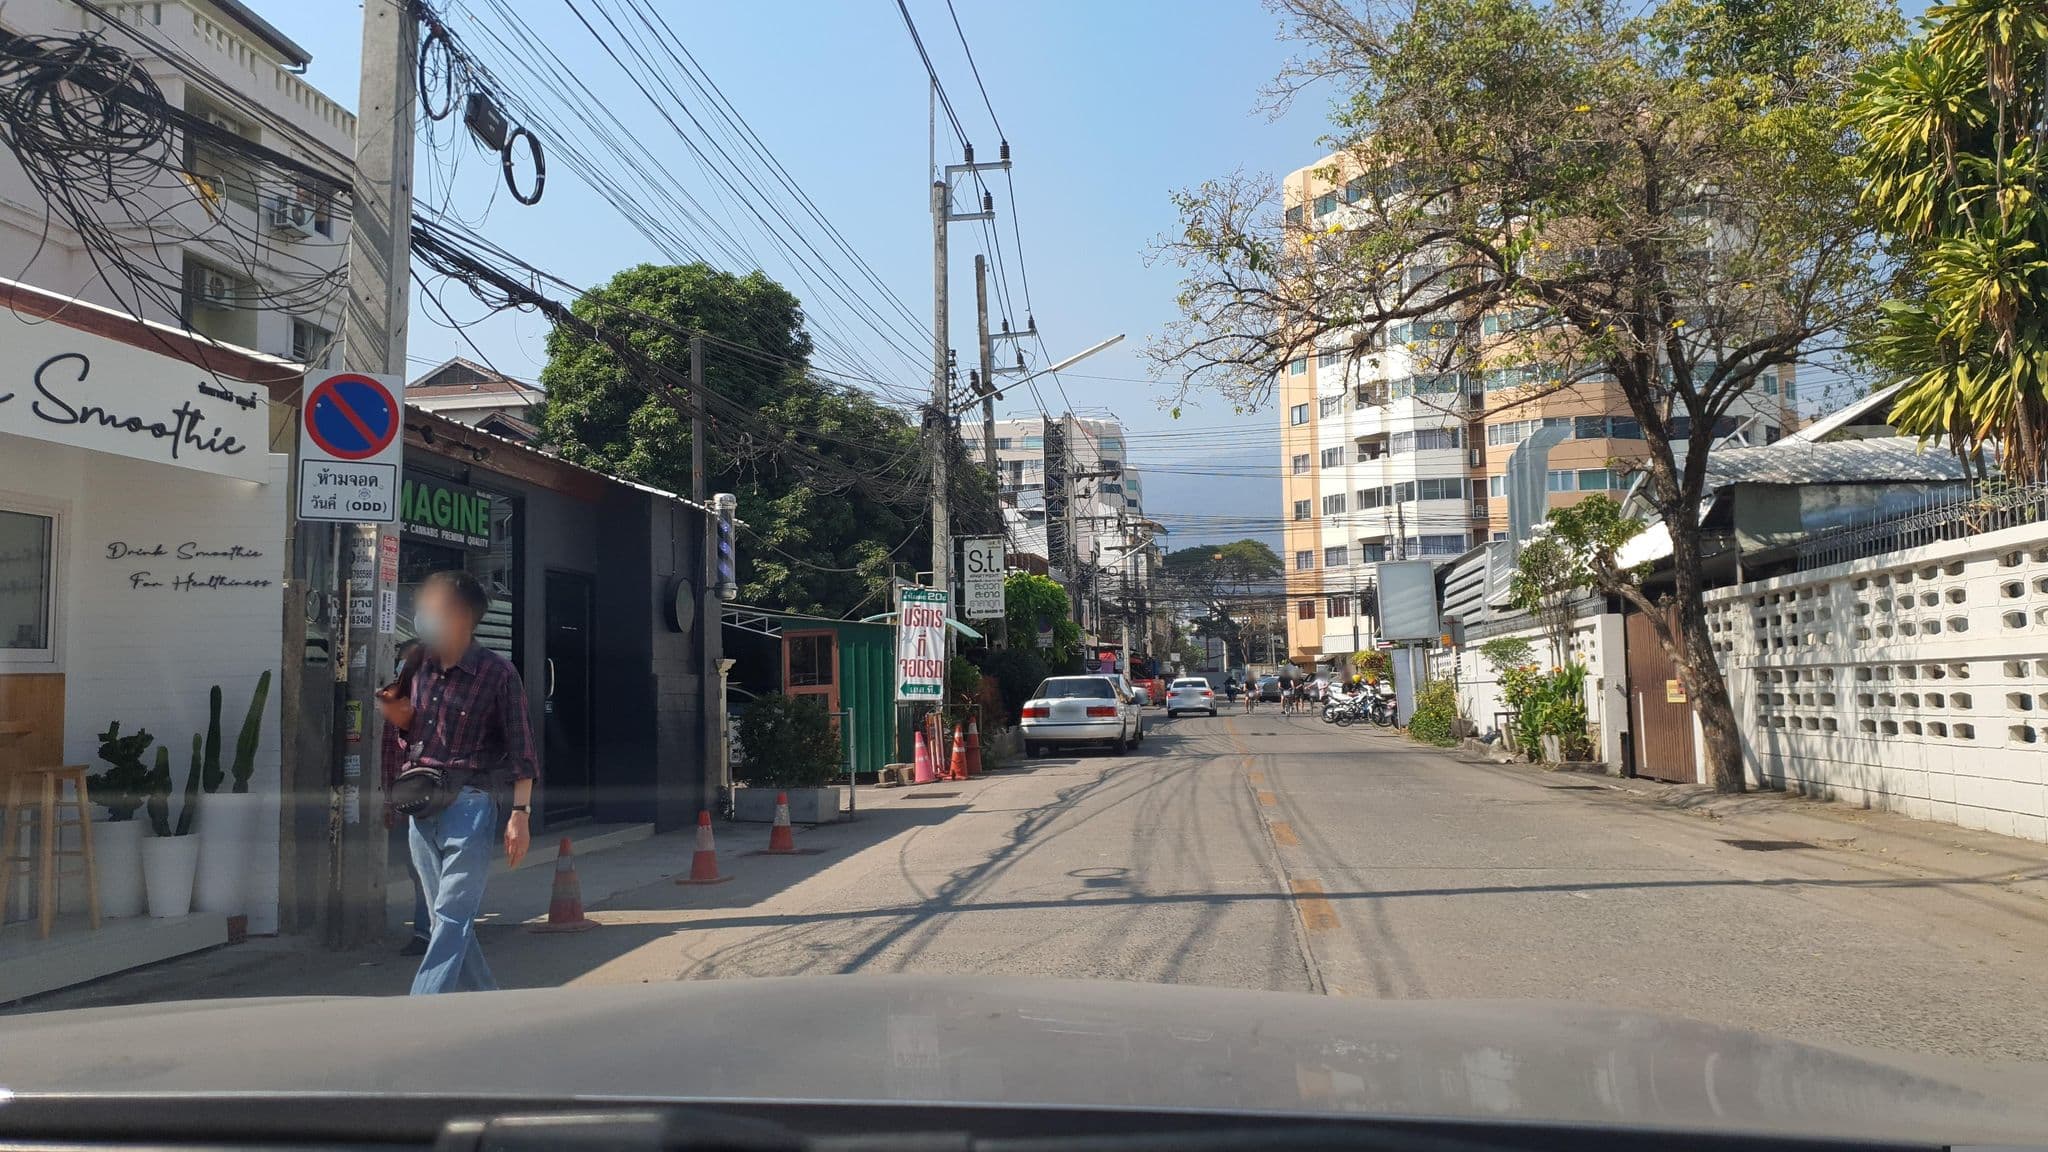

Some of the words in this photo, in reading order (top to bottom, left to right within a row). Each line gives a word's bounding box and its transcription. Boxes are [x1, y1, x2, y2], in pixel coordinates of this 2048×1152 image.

[32, 352, 246, 459] Smoothie
[316, 468, 379, 487] ห้ามจอด
[345, 499, 387, 513] (ODD)
[410, 524, 439, 538] CANNABIS
[441, 530, 465, 544] PREMIUM
[467, 536, 489, 548] QUALITY
[106, 541, 168, 560] Drink
[176, 541, 263, 560] Smoothie
[968, 549, 1001, 573] S.t.
[129, 571, 164, 590] For
[172, 572, 273, 592] Healthiness
[904, 604, 943, 628] บริการ
[899, 658, 943, 678] จอดรถ
